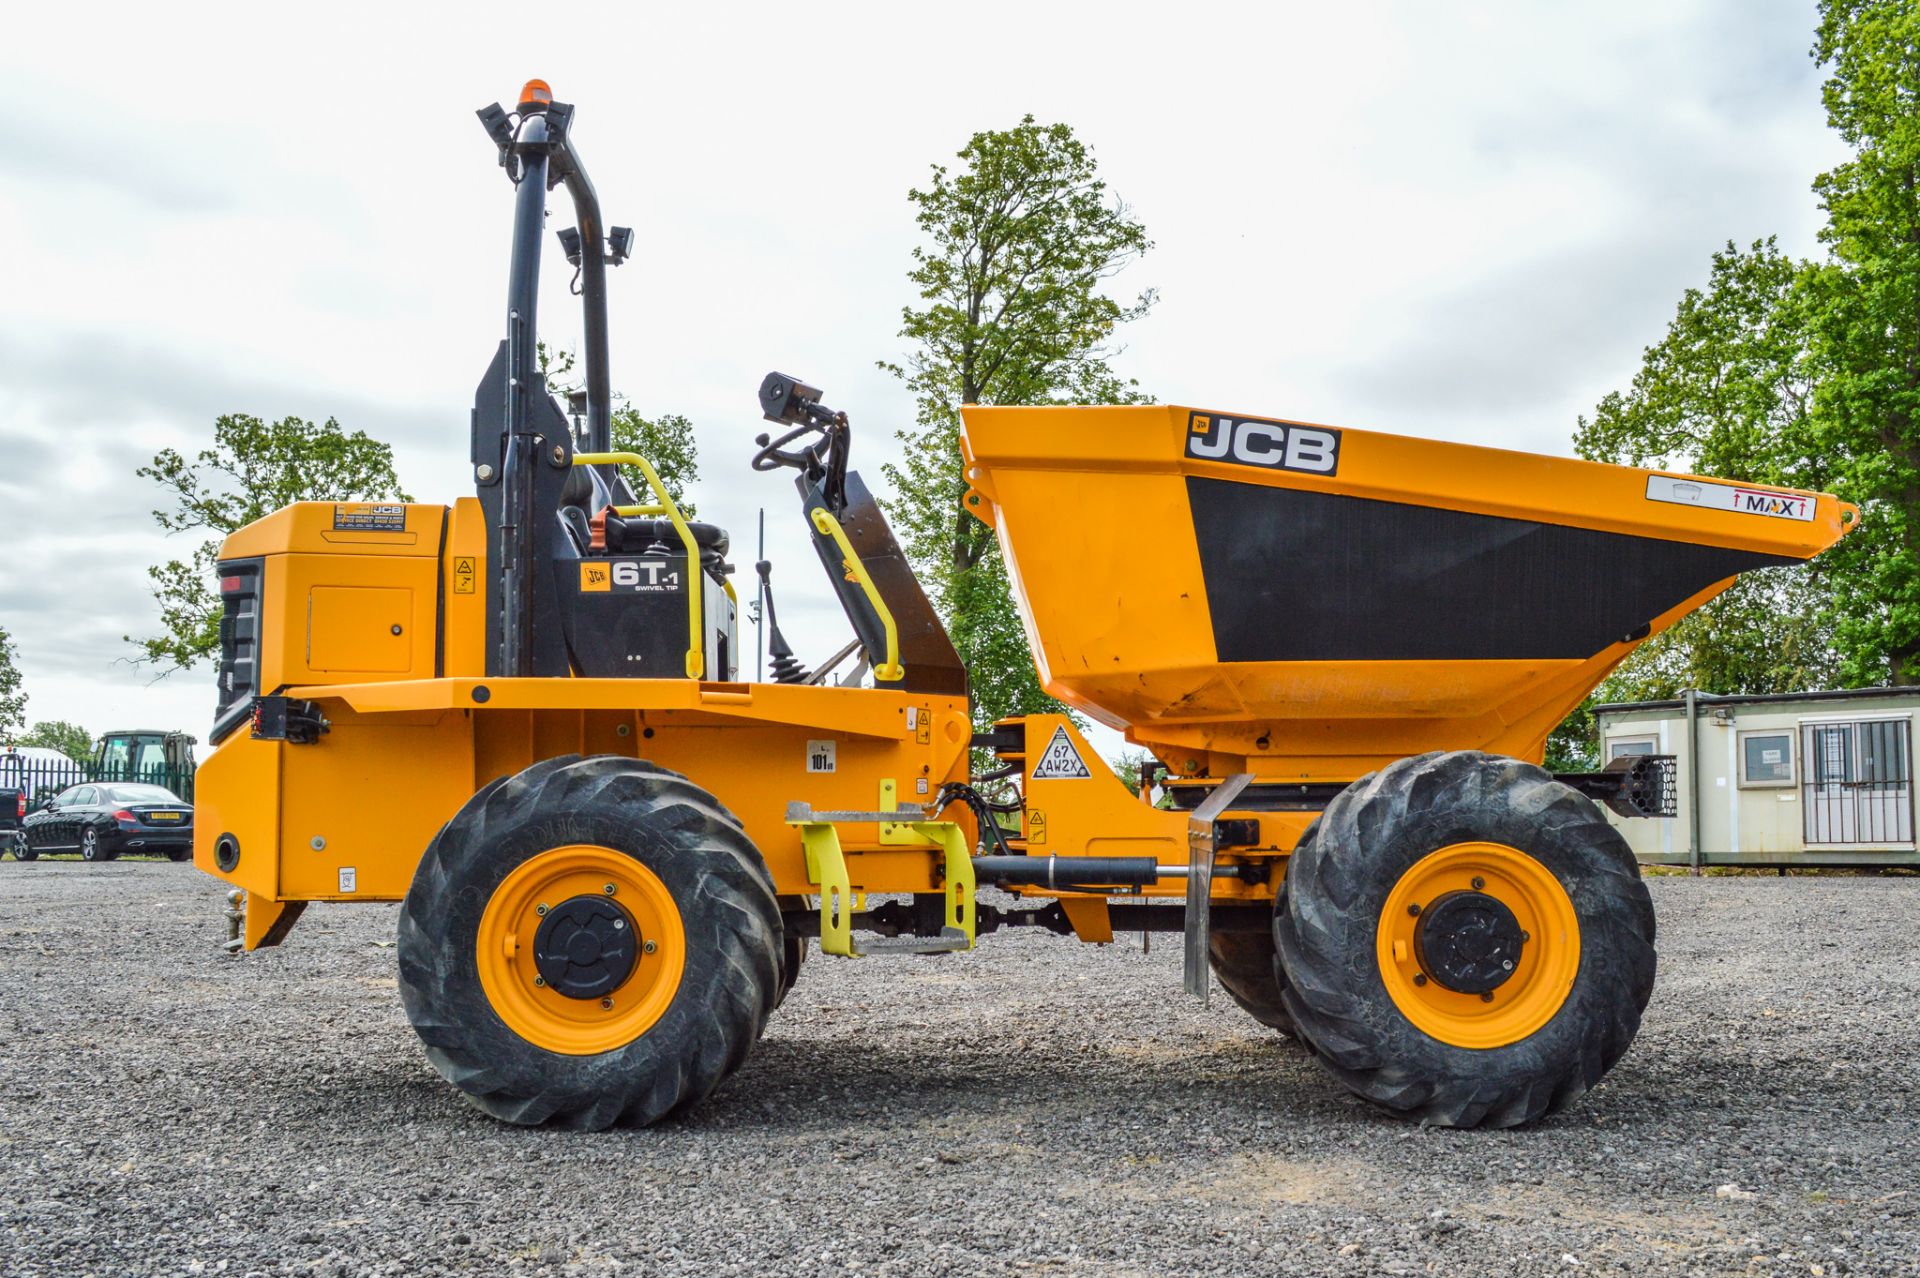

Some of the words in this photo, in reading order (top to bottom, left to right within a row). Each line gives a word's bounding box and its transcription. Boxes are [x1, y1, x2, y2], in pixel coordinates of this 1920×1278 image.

[1190, 419, 1336, 472] JCB
[373, 506, 402, 514] JCB
[589, 570, 606, 583] JCB
[1054, 746, 1069, 759] 67
[812, 754, 827, 770] 101
[1046, 760, 1077, 772] AW2X
